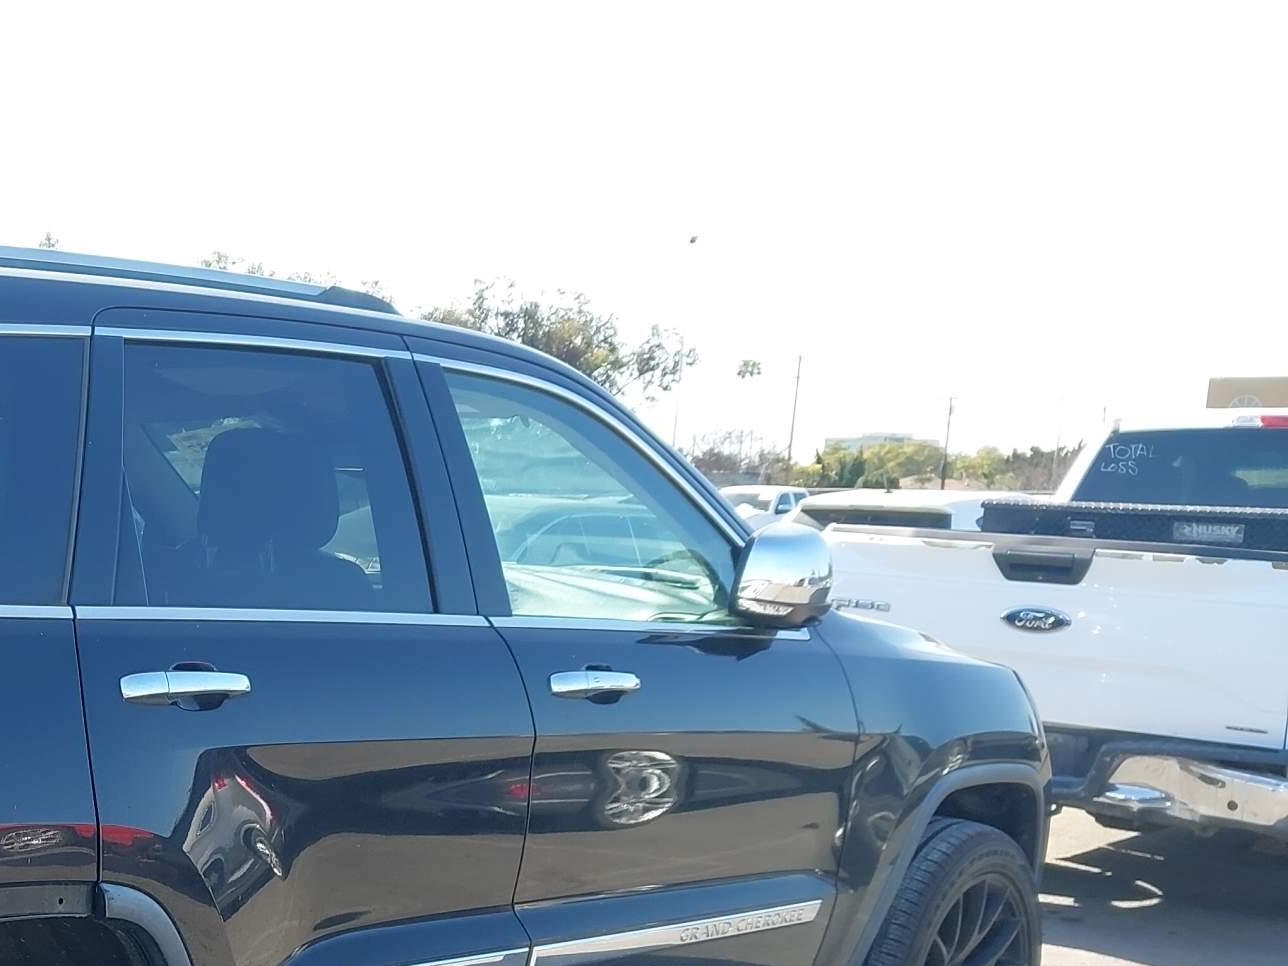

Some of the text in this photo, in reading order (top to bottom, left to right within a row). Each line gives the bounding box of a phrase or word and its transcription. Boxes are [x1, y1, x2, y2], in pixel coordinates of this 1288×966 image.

[1105, 442, 1154, 460] TOTAL
[1193, 522, 1241, 537] HUSKY
[1014, 611, 1056, 629] Ford
[679, 907, 806, 943] GRAND CHEROKEE
